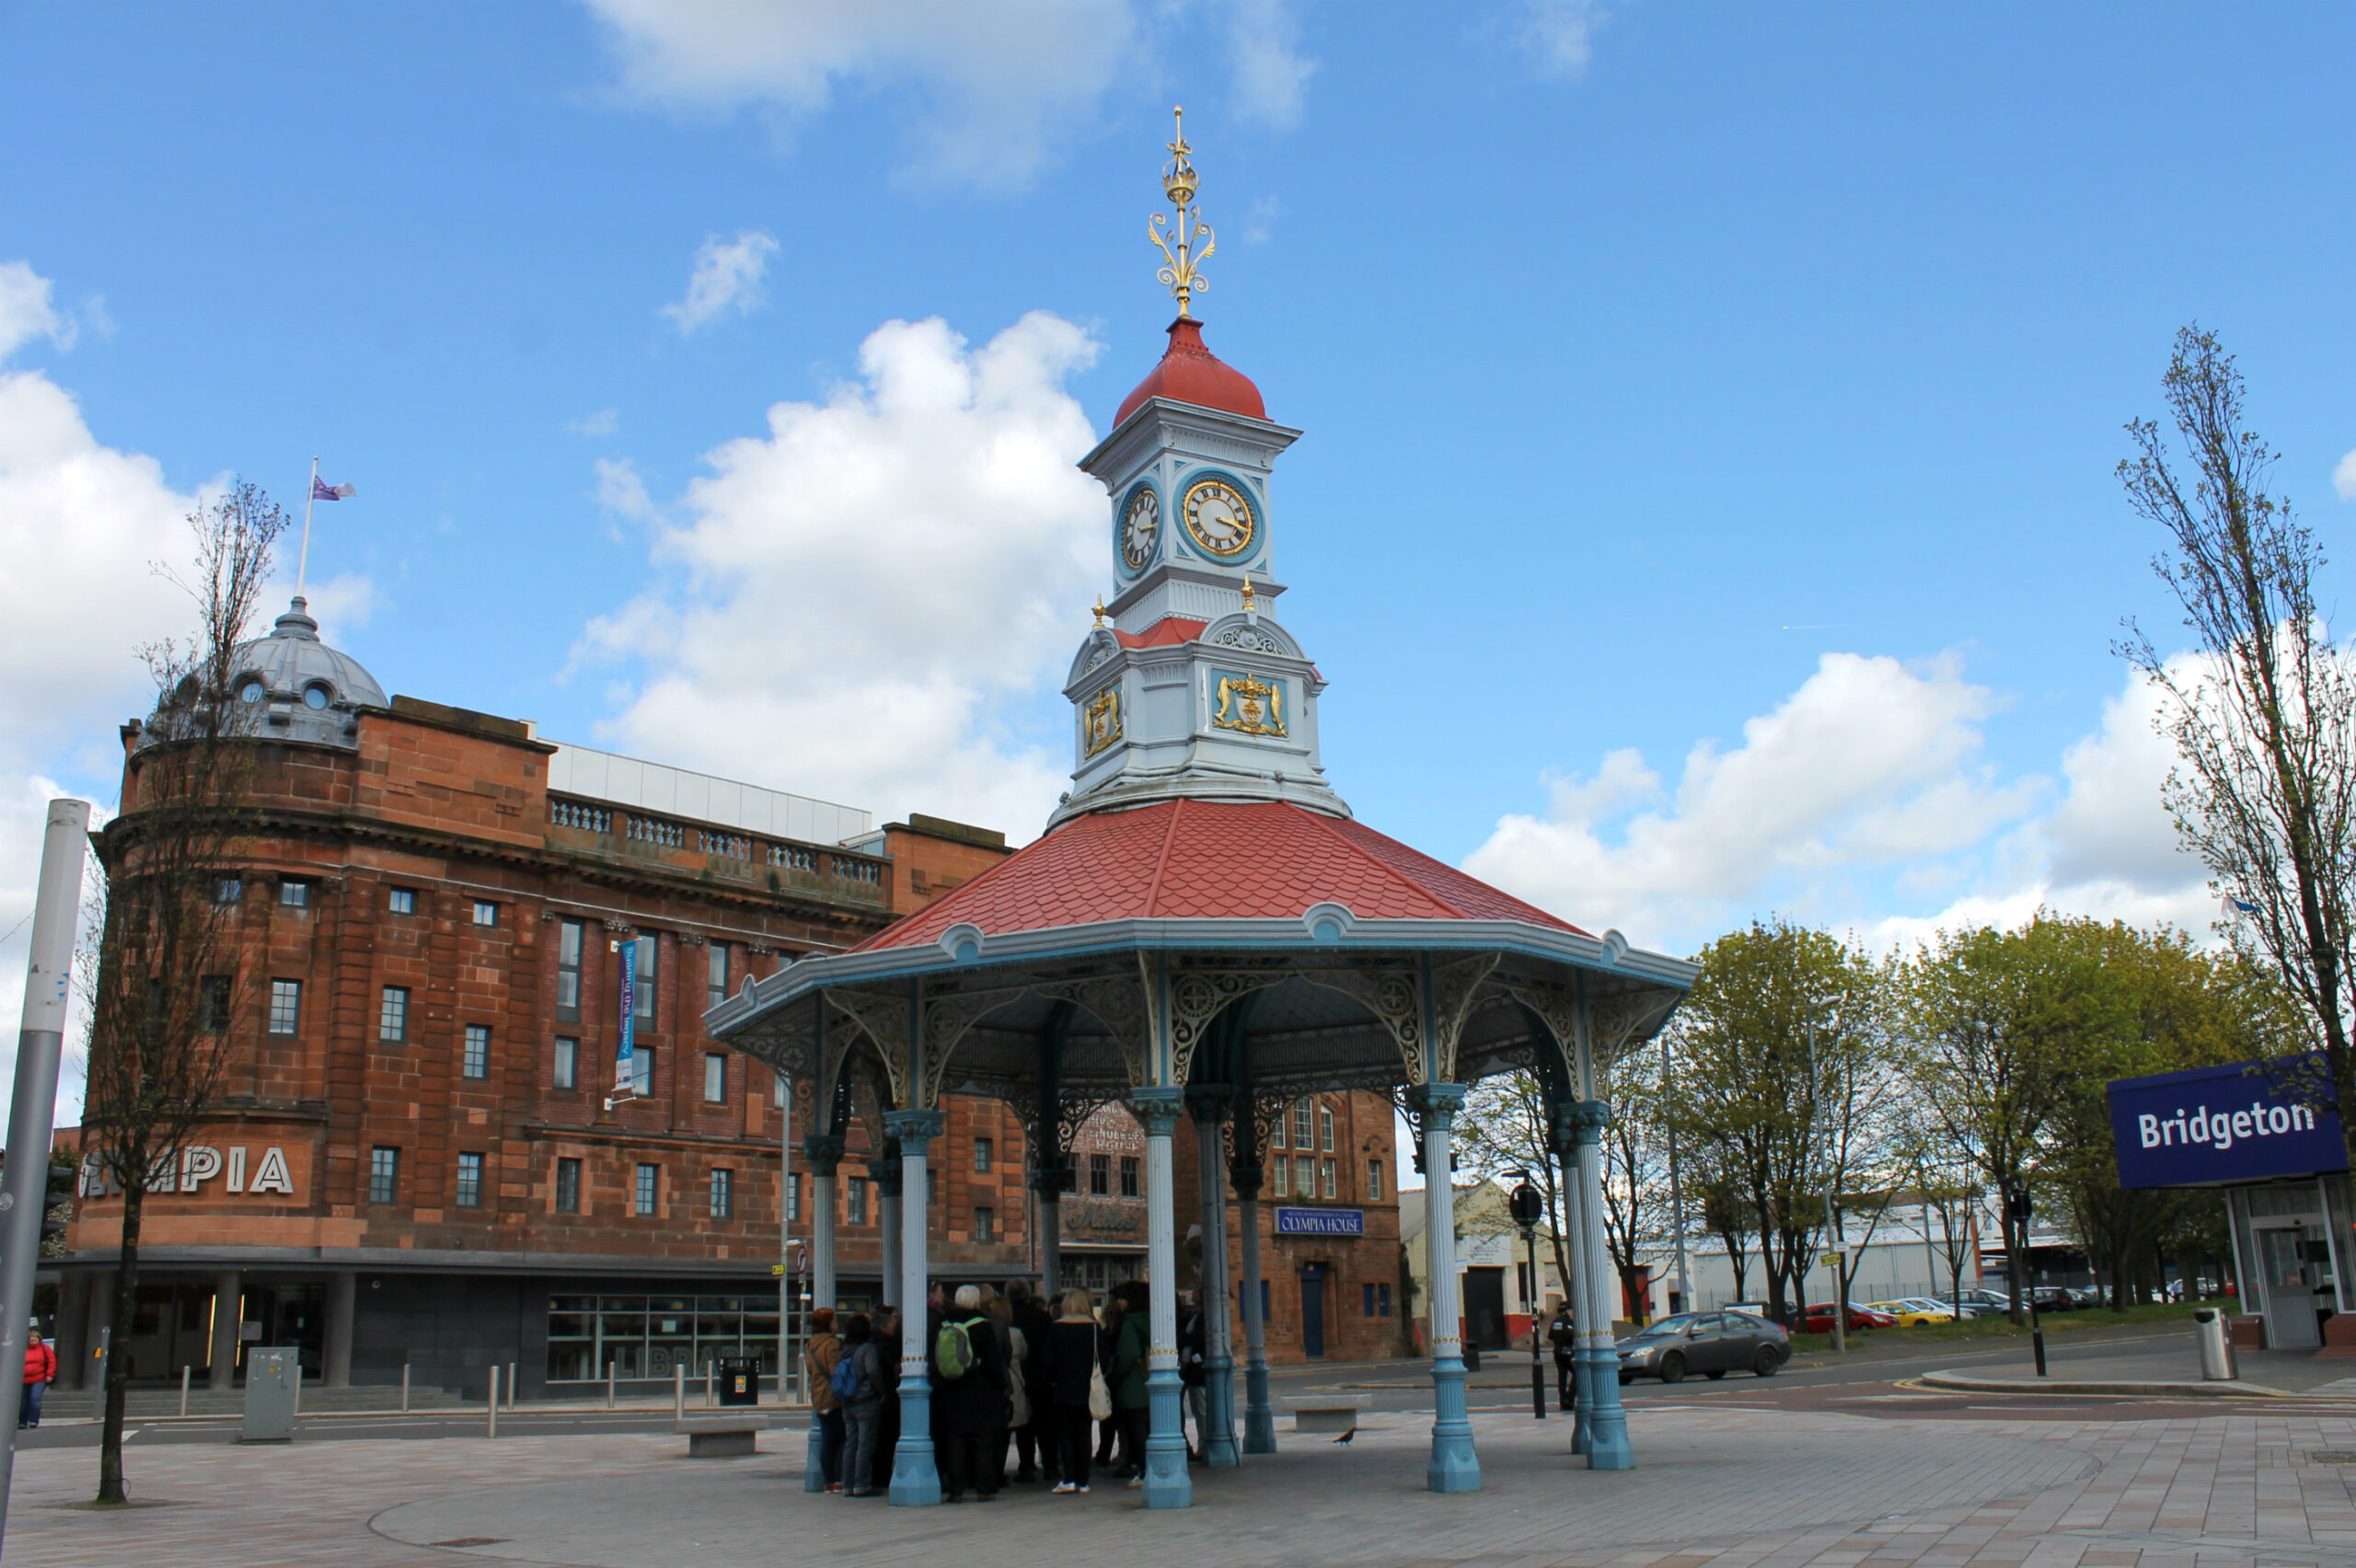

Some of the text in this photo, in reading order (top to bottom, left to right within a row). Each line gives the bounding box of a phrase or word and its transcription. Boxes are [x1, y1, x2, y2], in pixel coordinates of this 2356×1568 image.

[624, 946, 634, 993] Building
[621, 1017, 629, 1055] legacy
[2138, 1101, 2316, 1149] Bridgeton
[1282, 1216, 1359, 1232] OLYMPIA HOUSE
